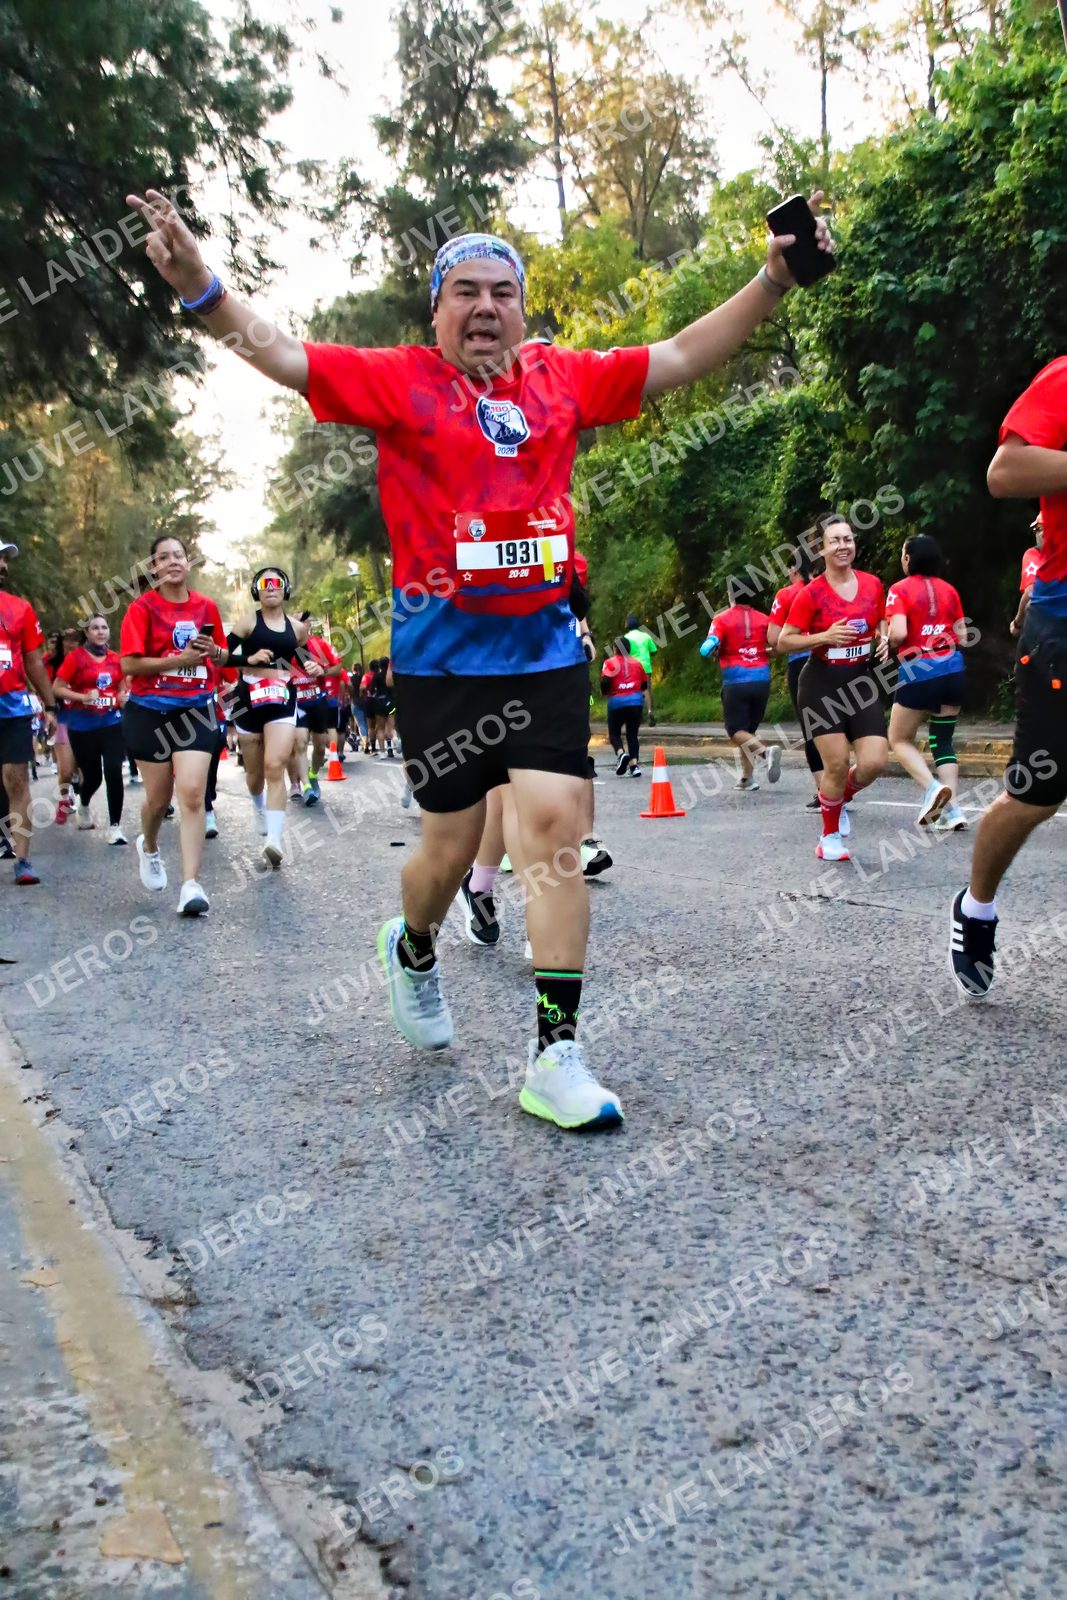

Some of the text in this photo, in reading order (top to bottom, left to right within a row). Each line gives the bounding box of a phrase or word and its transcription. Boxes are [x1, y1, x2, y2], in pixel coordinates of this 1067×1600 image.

[496, 540, 538, 566] 1931
[508, 569, 529, 578] 20-26
[845, 647, 862, 657] 3114
